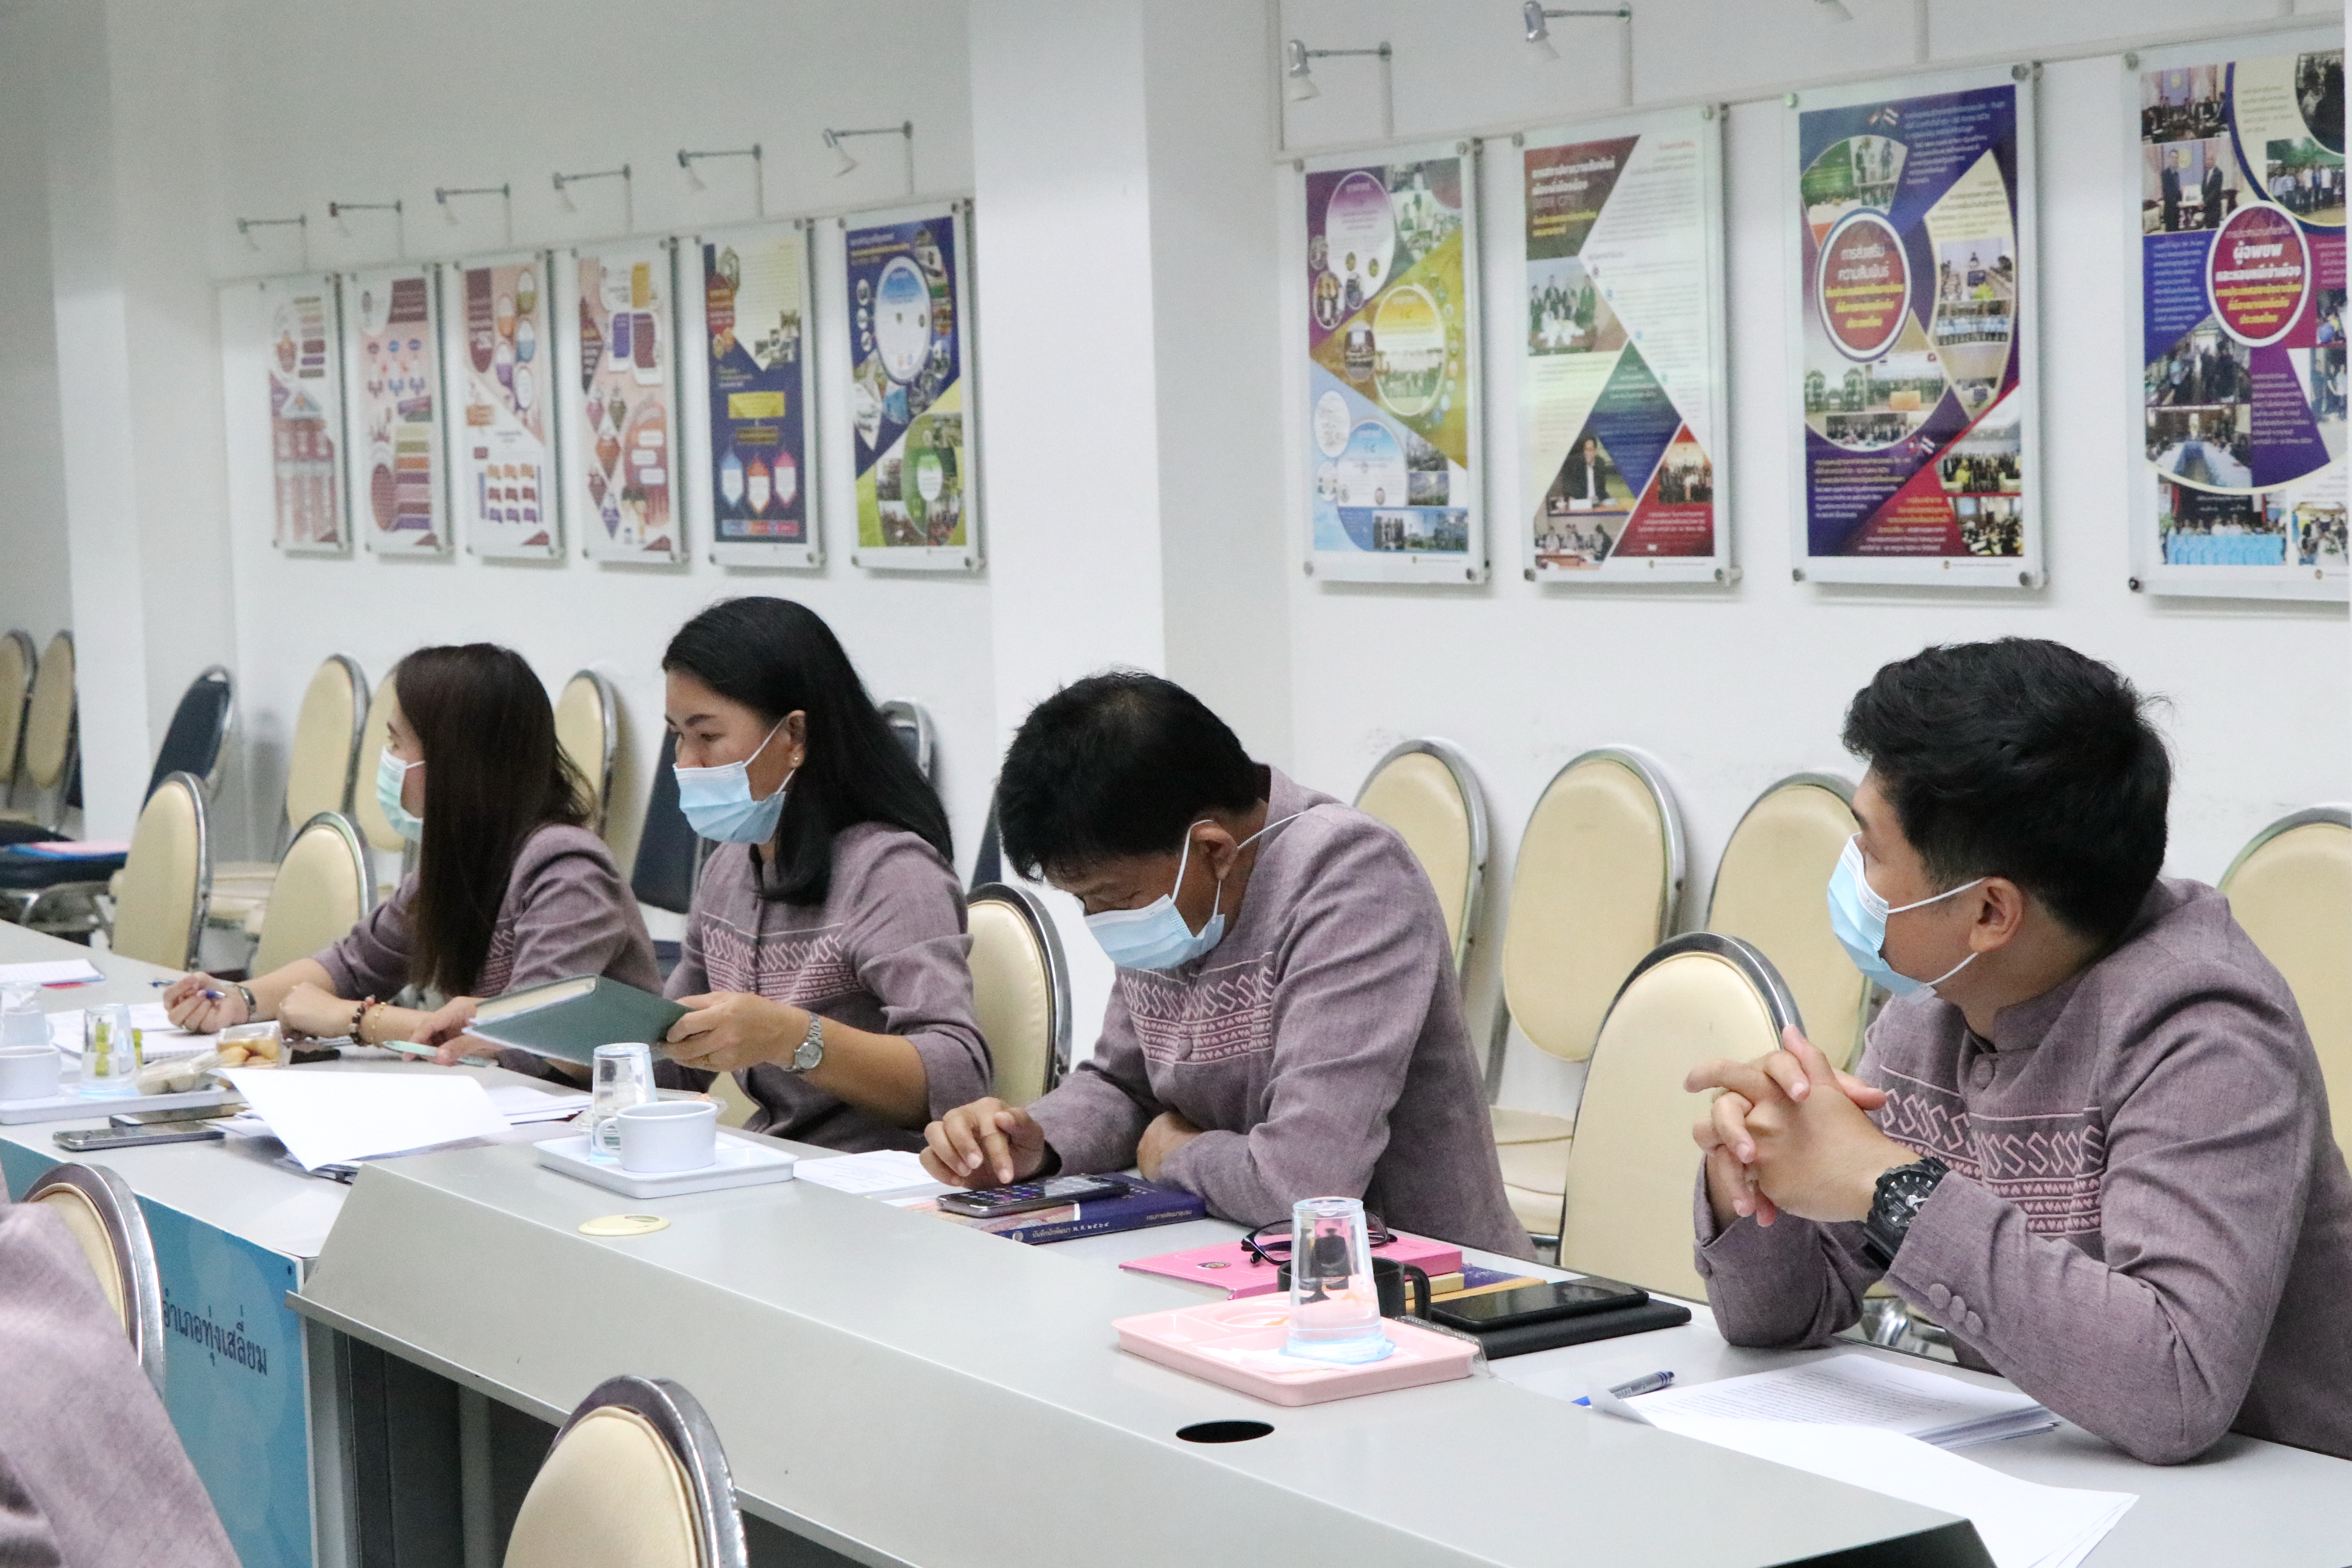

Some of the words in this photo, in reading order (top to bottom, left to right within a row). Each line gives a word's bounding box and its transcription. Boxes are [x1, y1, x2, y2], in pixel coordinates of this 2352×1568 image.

[2232, 240, 2283, 265] ผู้อพยพ
[1838, 261, 1890, 281] ความสัมพันธ์
